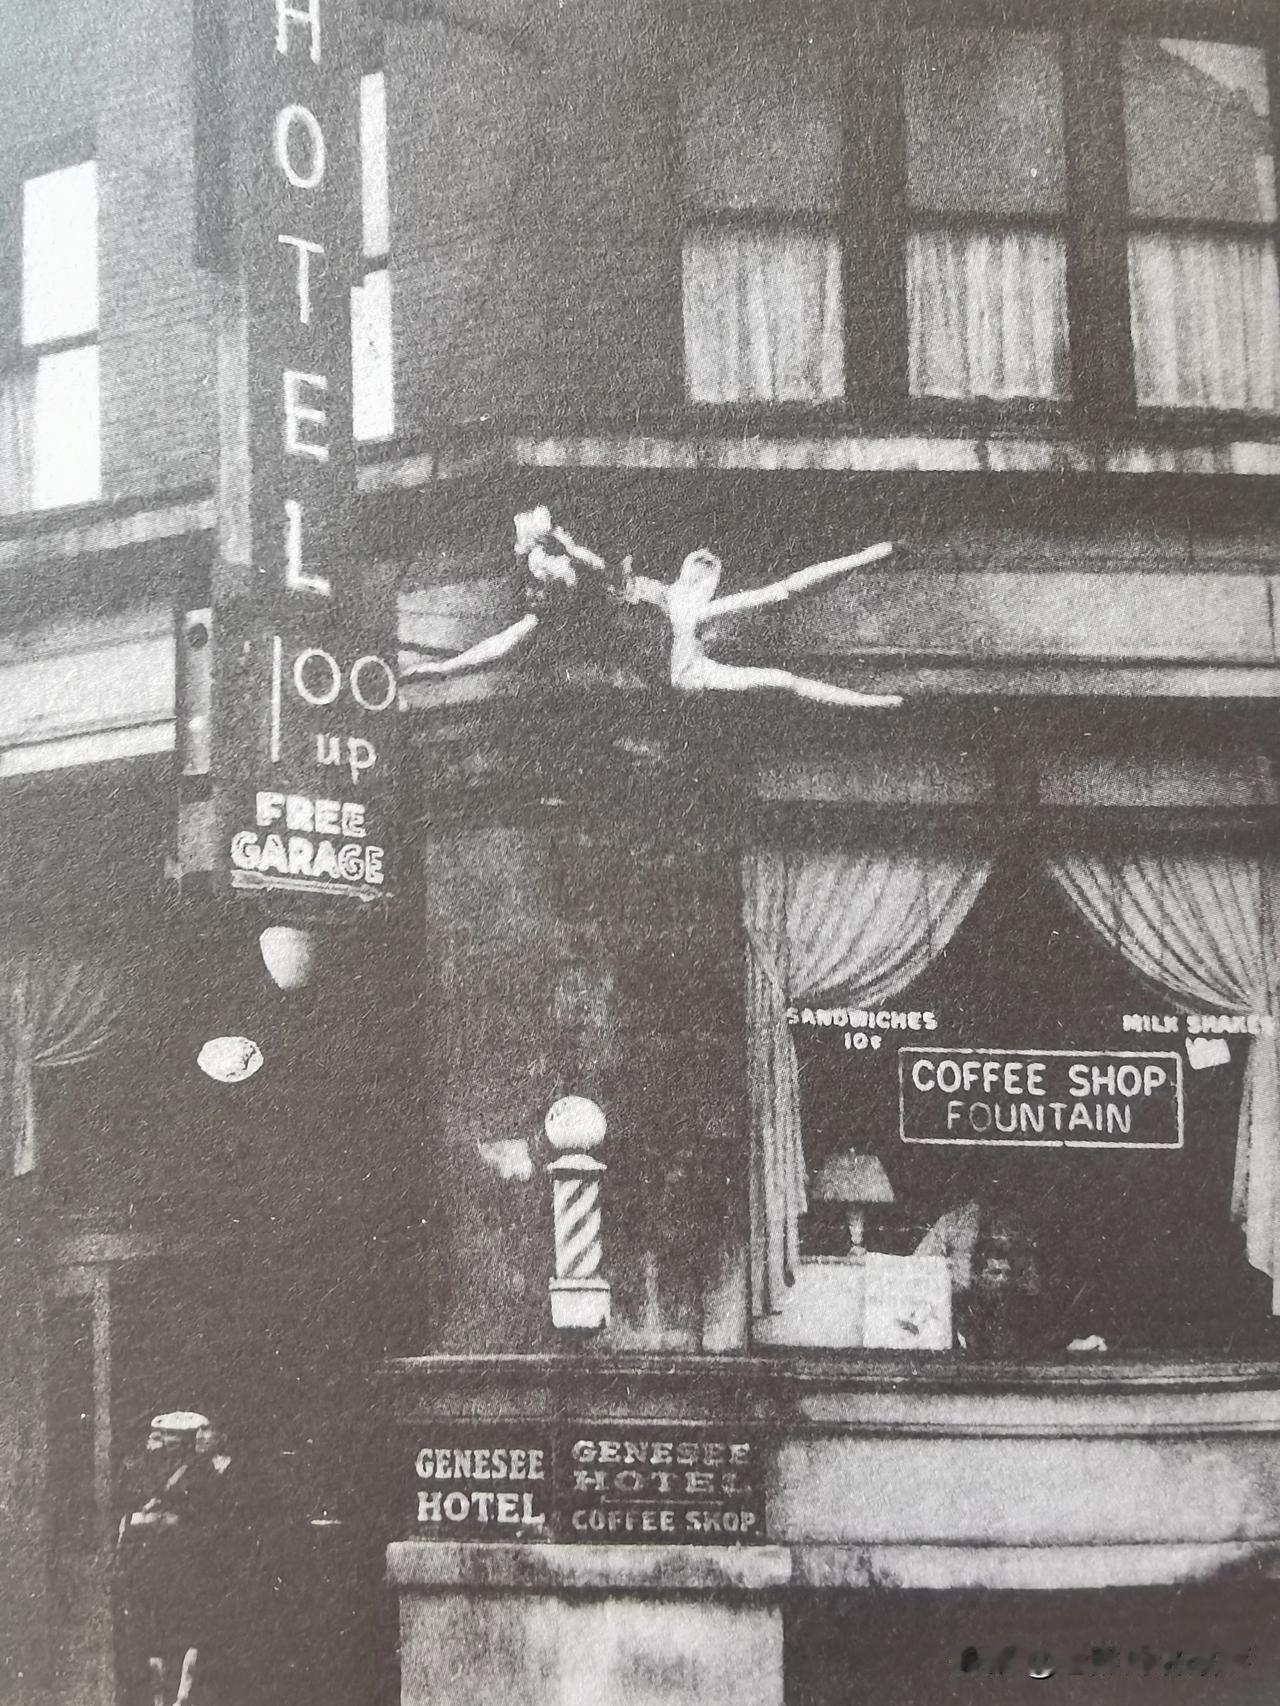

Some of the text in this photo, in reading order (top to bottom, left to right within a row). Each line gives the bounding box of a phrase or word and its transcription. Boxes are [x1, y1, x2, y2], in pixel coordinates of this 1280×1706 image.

[272, 0, 331, 595] HOTEL
[316, 733, 377, 785] up
[255, 791, 367, 838] FREE
[230, 830, 385, 884] GARAGE
[785, 1007, 938, 1030] SANDWICHES
[1122, 1013, 1179, 1033] MILK
[911, 1059, 1167, 1097] COFFEE SHOP
[946, 1100, 1133, 1134] FOUNTAIN
[415, 1448, 545, 1481] GENESEE
[572, 1439, 751, 1466] GENESEE
[573, 1469, 752, 1496] HOTEL
[417, 1491, 546, 1525] HOTEL
[571, 1509, 675, 1532] COFFEE
